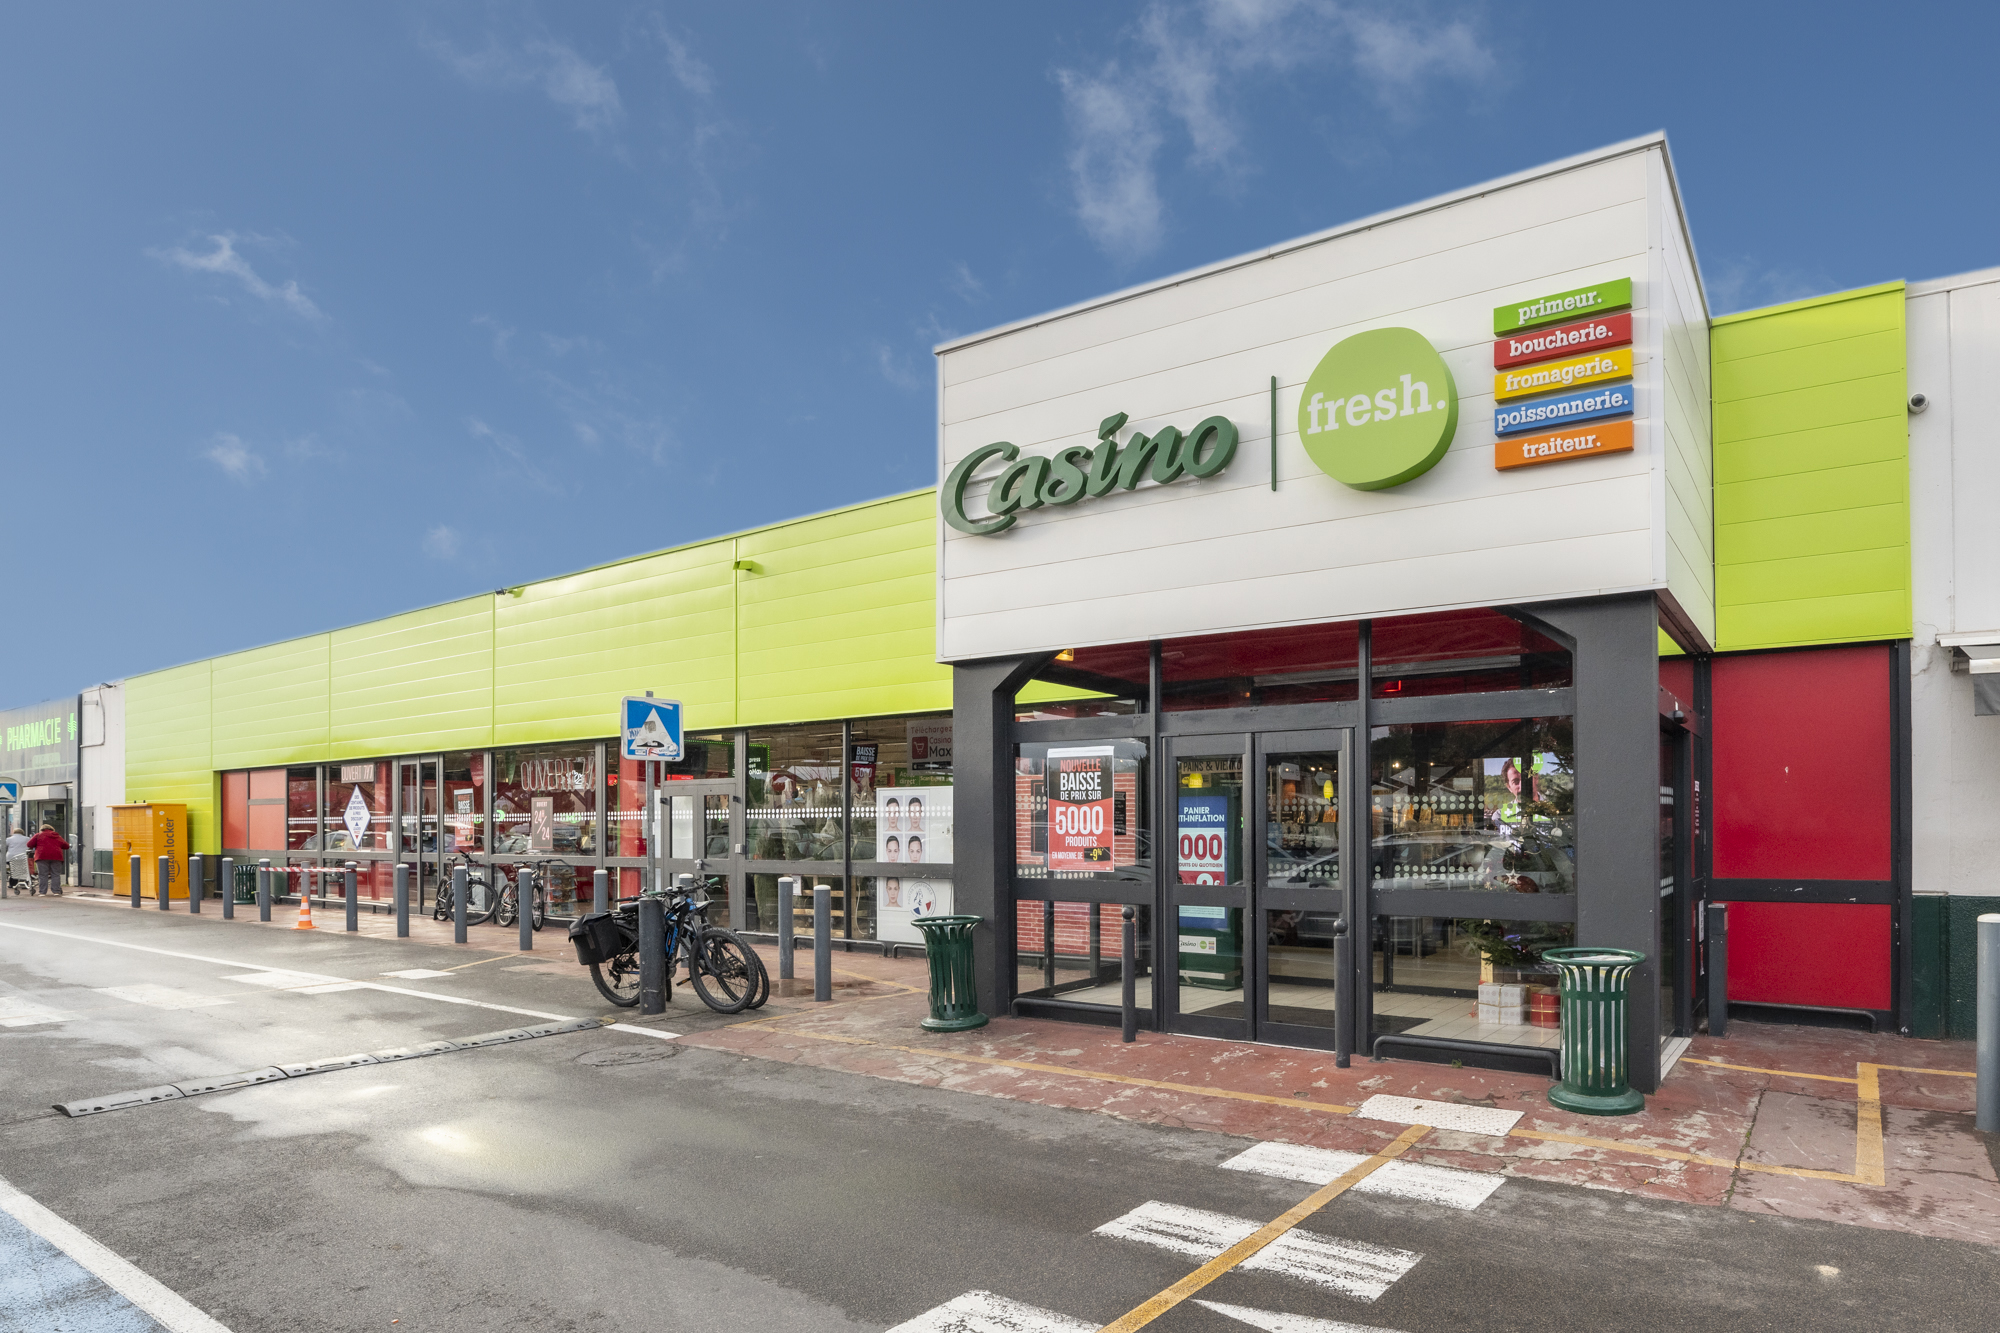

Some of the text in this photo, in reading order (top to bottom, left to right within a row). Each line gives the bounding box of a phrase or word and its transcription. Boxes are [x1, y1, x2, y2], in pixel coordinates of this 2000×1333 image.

[1518, 288, 1602, 325] primeur.
[1509, 323, 1613, 357] boucherie.
[1505, 355, 1619, 392] fromagerie.
[1306, 373, 1446, 435] fresh.
[1497, 391, 1629, 431] poissonnerie.
[1522, 433, 1602, 458] traiteur.
[941, 412, 1239, 535] Casino
[7, 717, 61, 752] PHARMACIE
[911, 726, 952, 734] Téléchargez
[929, 736, 952, 744] Casino
[856, 746, 876, 756] BAISSE
[929, 746, 952, 757] Max
[341, 766, 361, 781] OUVERT
[1060, 758, 1101, 772] NOUVELLE
[1206, 761, 1213, 770] &
[1060, 772, 1102, 791] BAISSE
[1060, 790, 1102, 800] DE PRIX SUR
[1055, 806, 1104, 835] 5000
[1178, 814, 1225, 822] TI-INFLATION
[163, 817, 175, 848] locker
[1065, 836, 1097, 847] PRODUITS
[1051, 851, 1058, 859] EN
[1058, 851, 1077, 859] MOYENNE
[1077, 851, 1084, 860] DE
